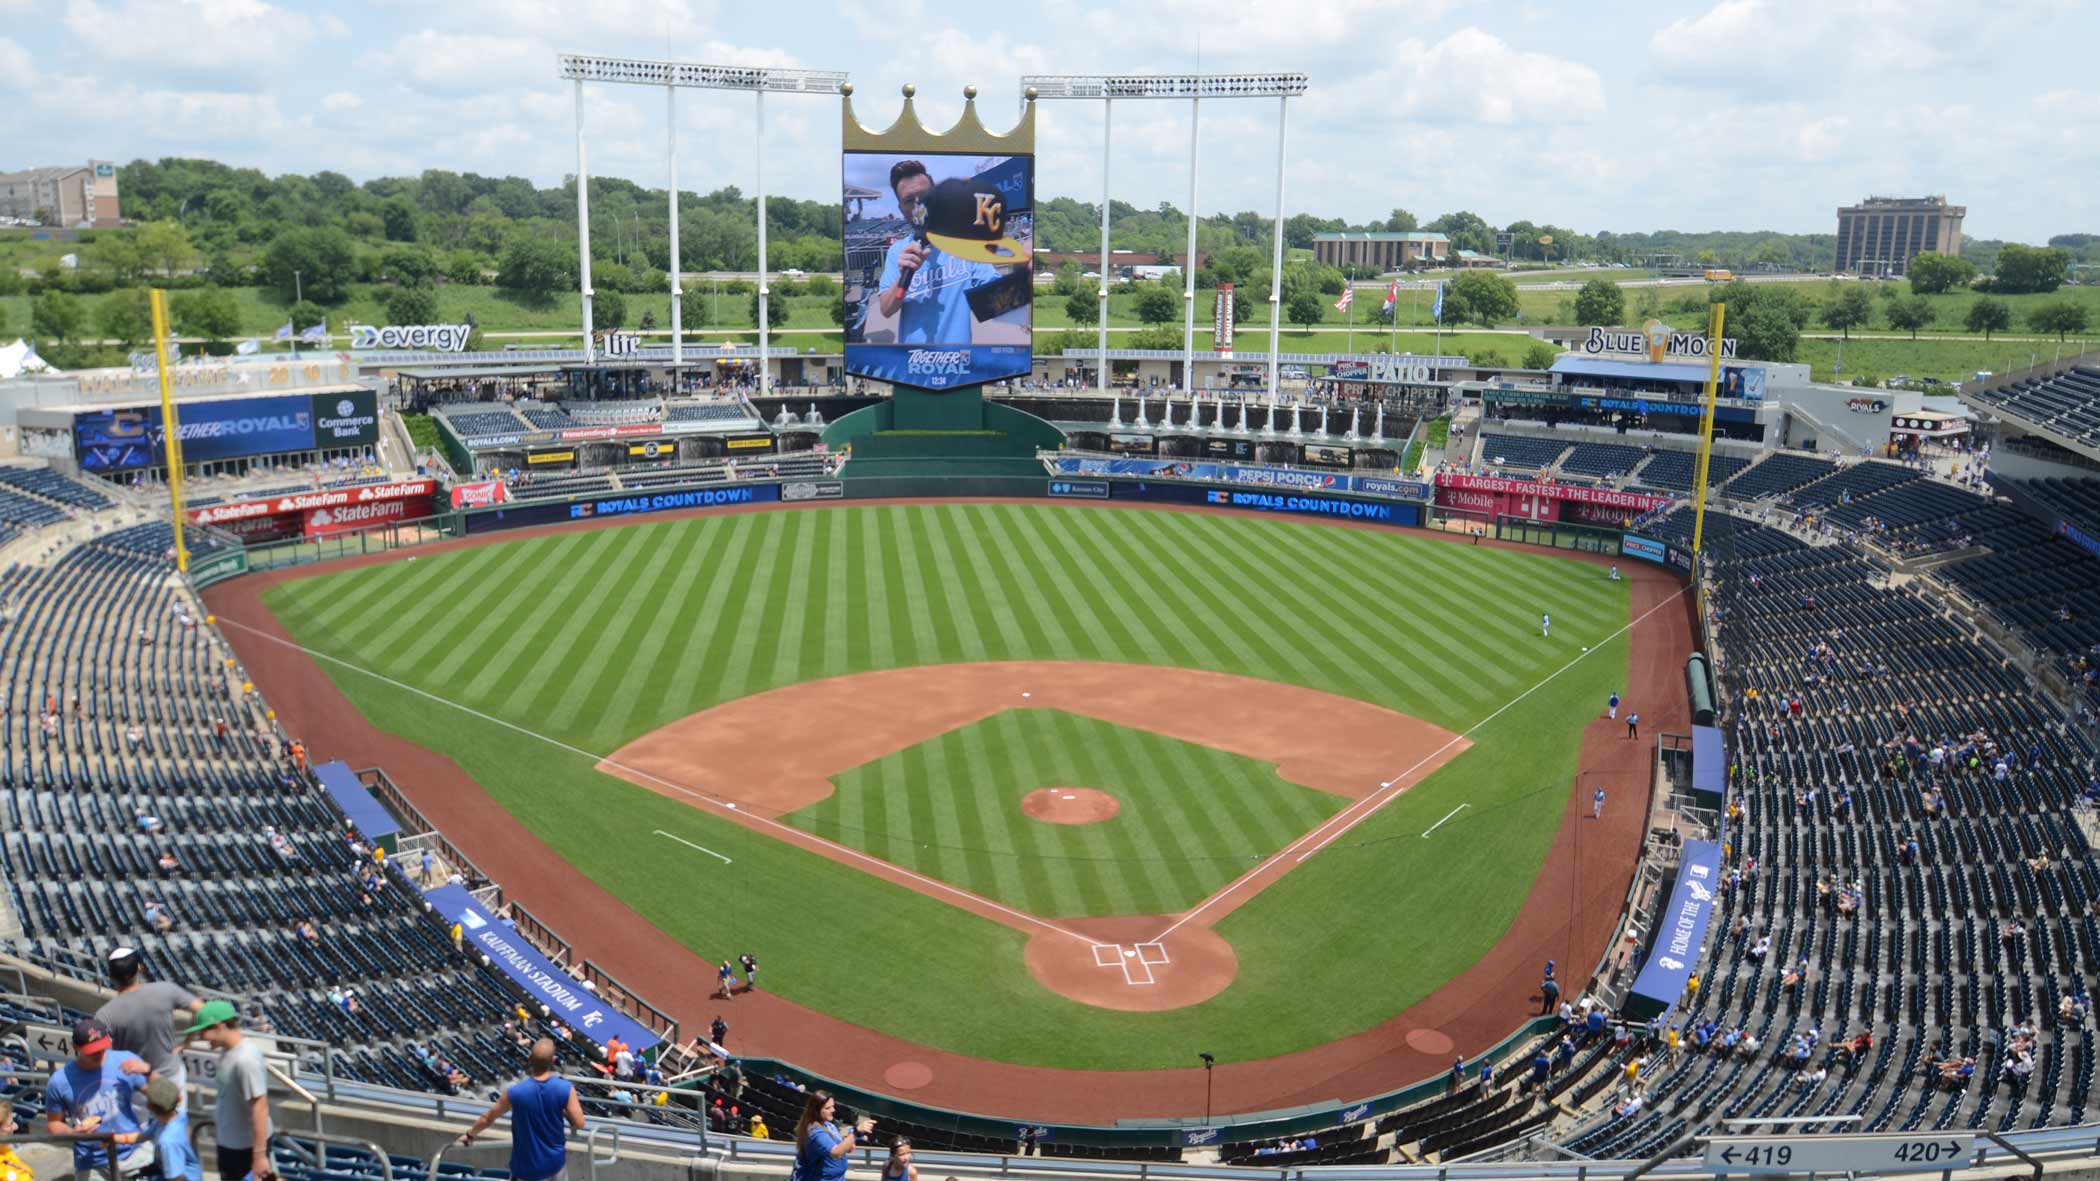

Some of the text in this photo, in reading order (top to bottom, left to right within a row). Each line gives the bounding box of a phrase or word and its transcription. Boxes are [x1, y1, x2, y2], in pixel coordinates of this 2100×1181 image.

[381, 326, 470, 350] evergy
[907, 349, 960, 364] TOGETHER
[908, 363, 971, 374] ROYAL
[1371, 362, 1430, 382] PATIO
[222, 415, 298, 435] ROYAL
[318, 415, 374, 429] Commerce
[334, 426, 360, 437] Bank
[1238, 468, 1322, 486] PEPSI PORCH
[1366, 482, 1419, 494] royals.com
[1463, 478, 1513, 491] LARGEST.
[1516, 482, 1565, 497] FASTEST.
[1568, 488, 1589, 499] THE
[1591, 491, 1635, 507] LEADER
[1638, 497, 1650, 508] IN
[597, 496, 649, 513] ROYALS
[652, 488, 753, 509] COUNTDOWN
[1233, 492, 1284, 507] ROYALS
[1287, 498, 1391, 518] COUNTDOWN
[1594, 504, 1634, 522] Mobil
[479, 930, 583, 1012] KAUFFMAN STADIUM
[1745, 1145, 1793, 1166] 419
[1894, 1142, 1940, 1162] 420
